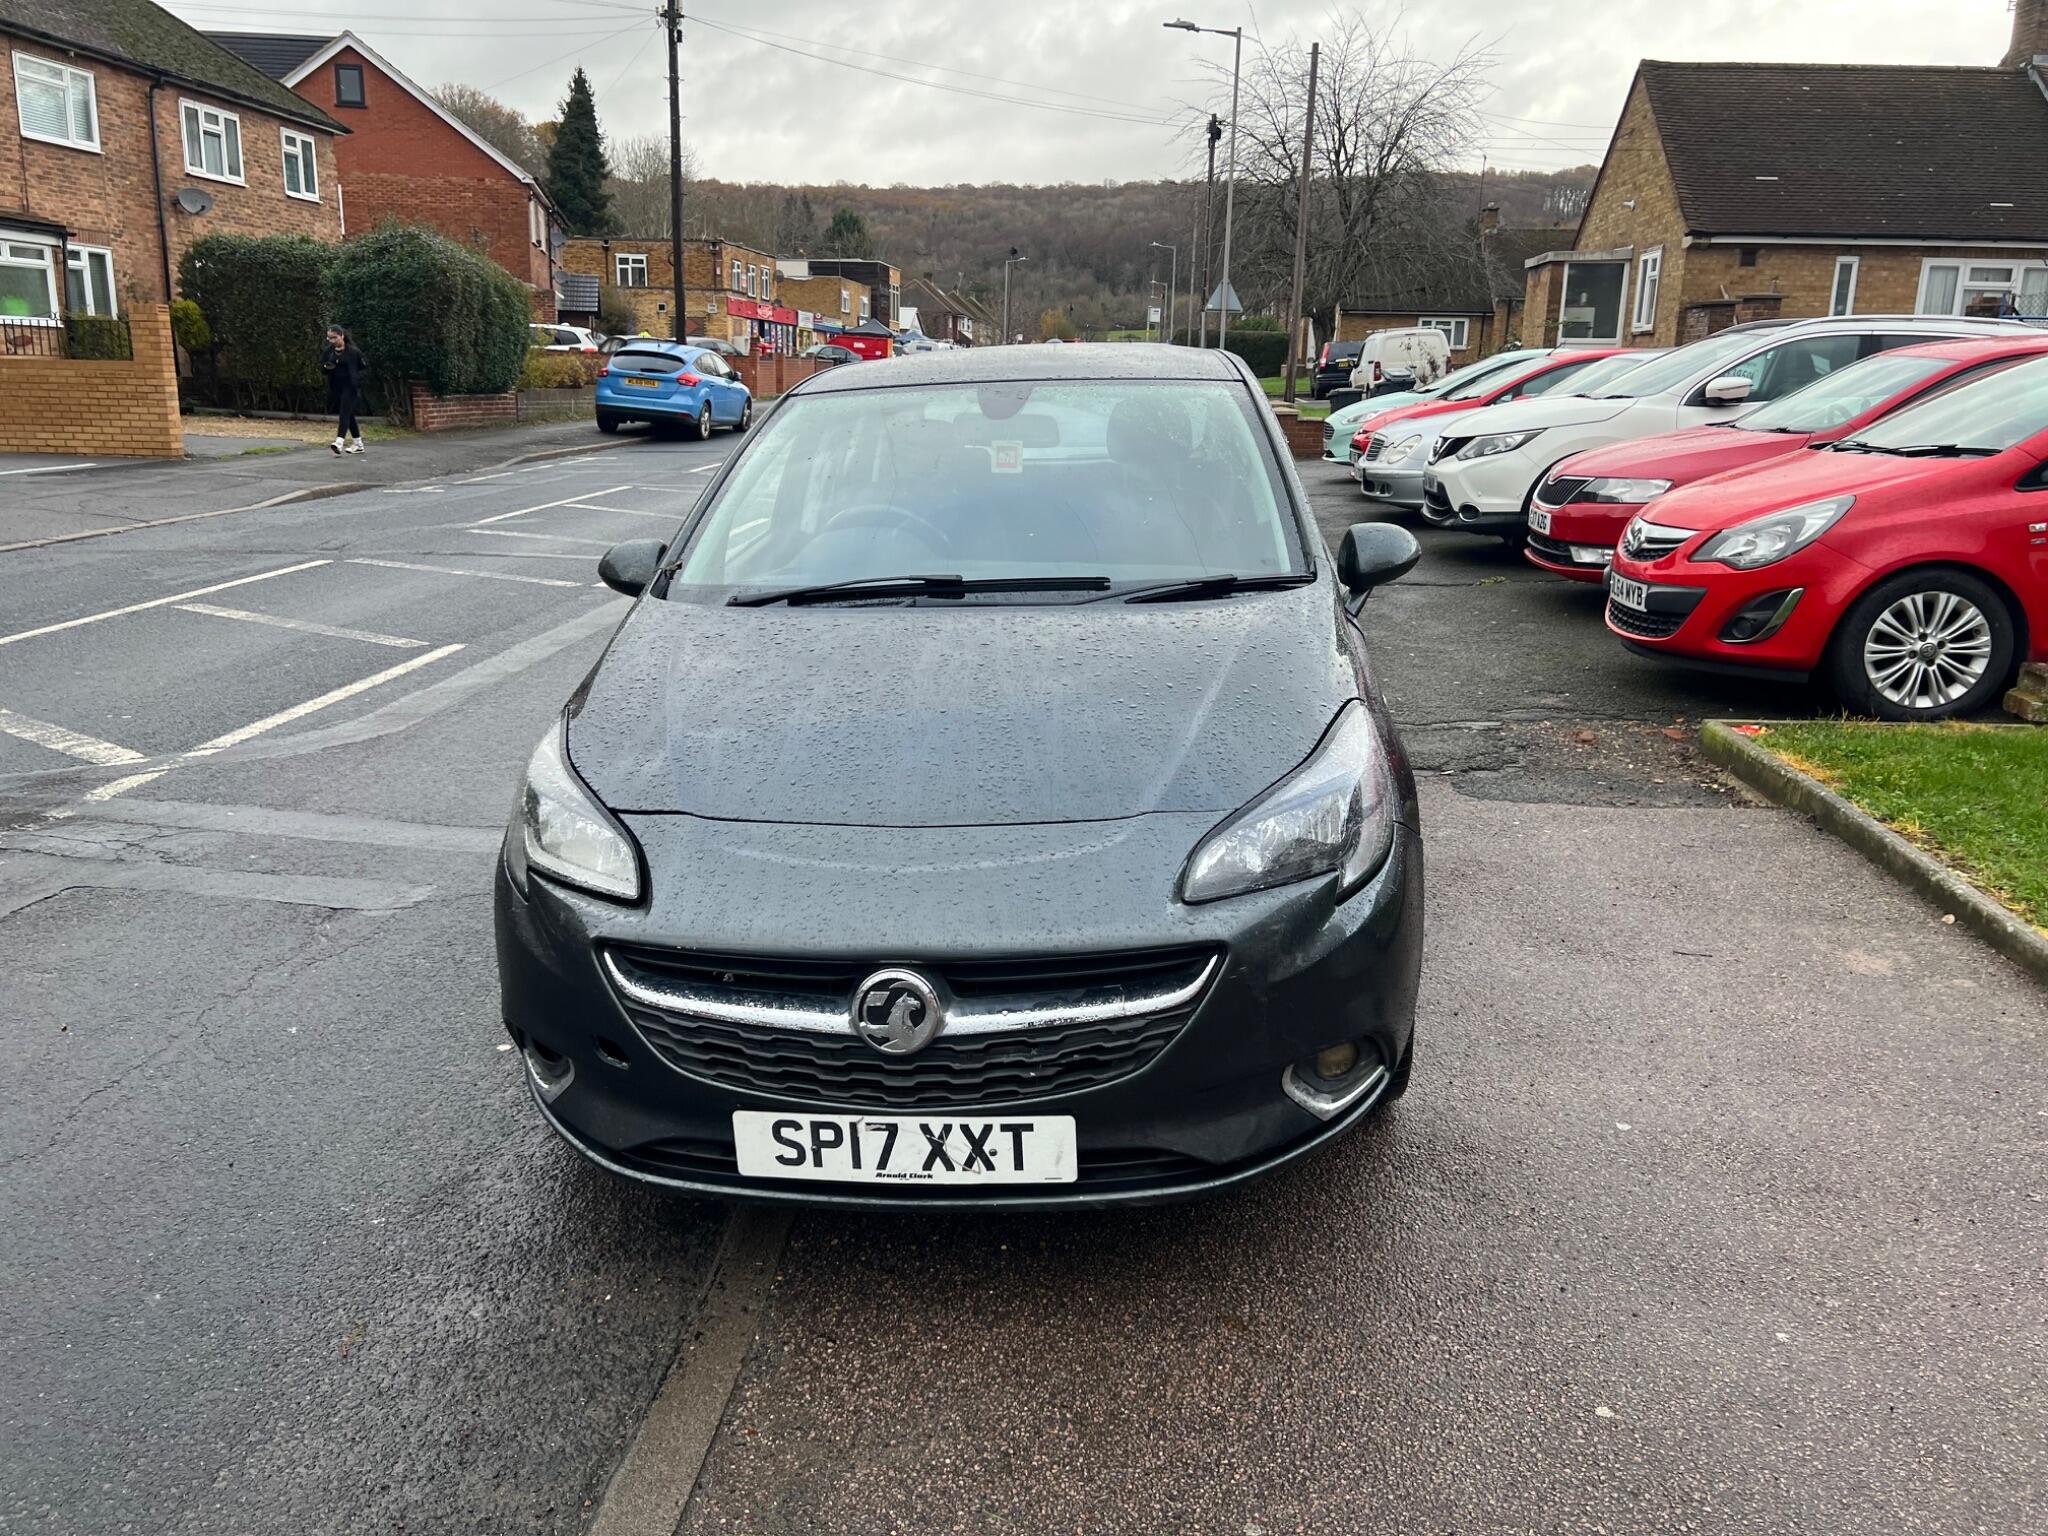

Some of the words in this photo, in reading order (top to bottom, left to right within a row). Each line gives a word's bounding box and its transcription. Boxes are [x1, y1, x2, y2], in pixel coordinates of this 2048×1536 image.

[1625, 581, 1643, 606] MYB
[771, 1118, 899, 1171] SP17
[918, 1122, 1035, 1172] XXT
